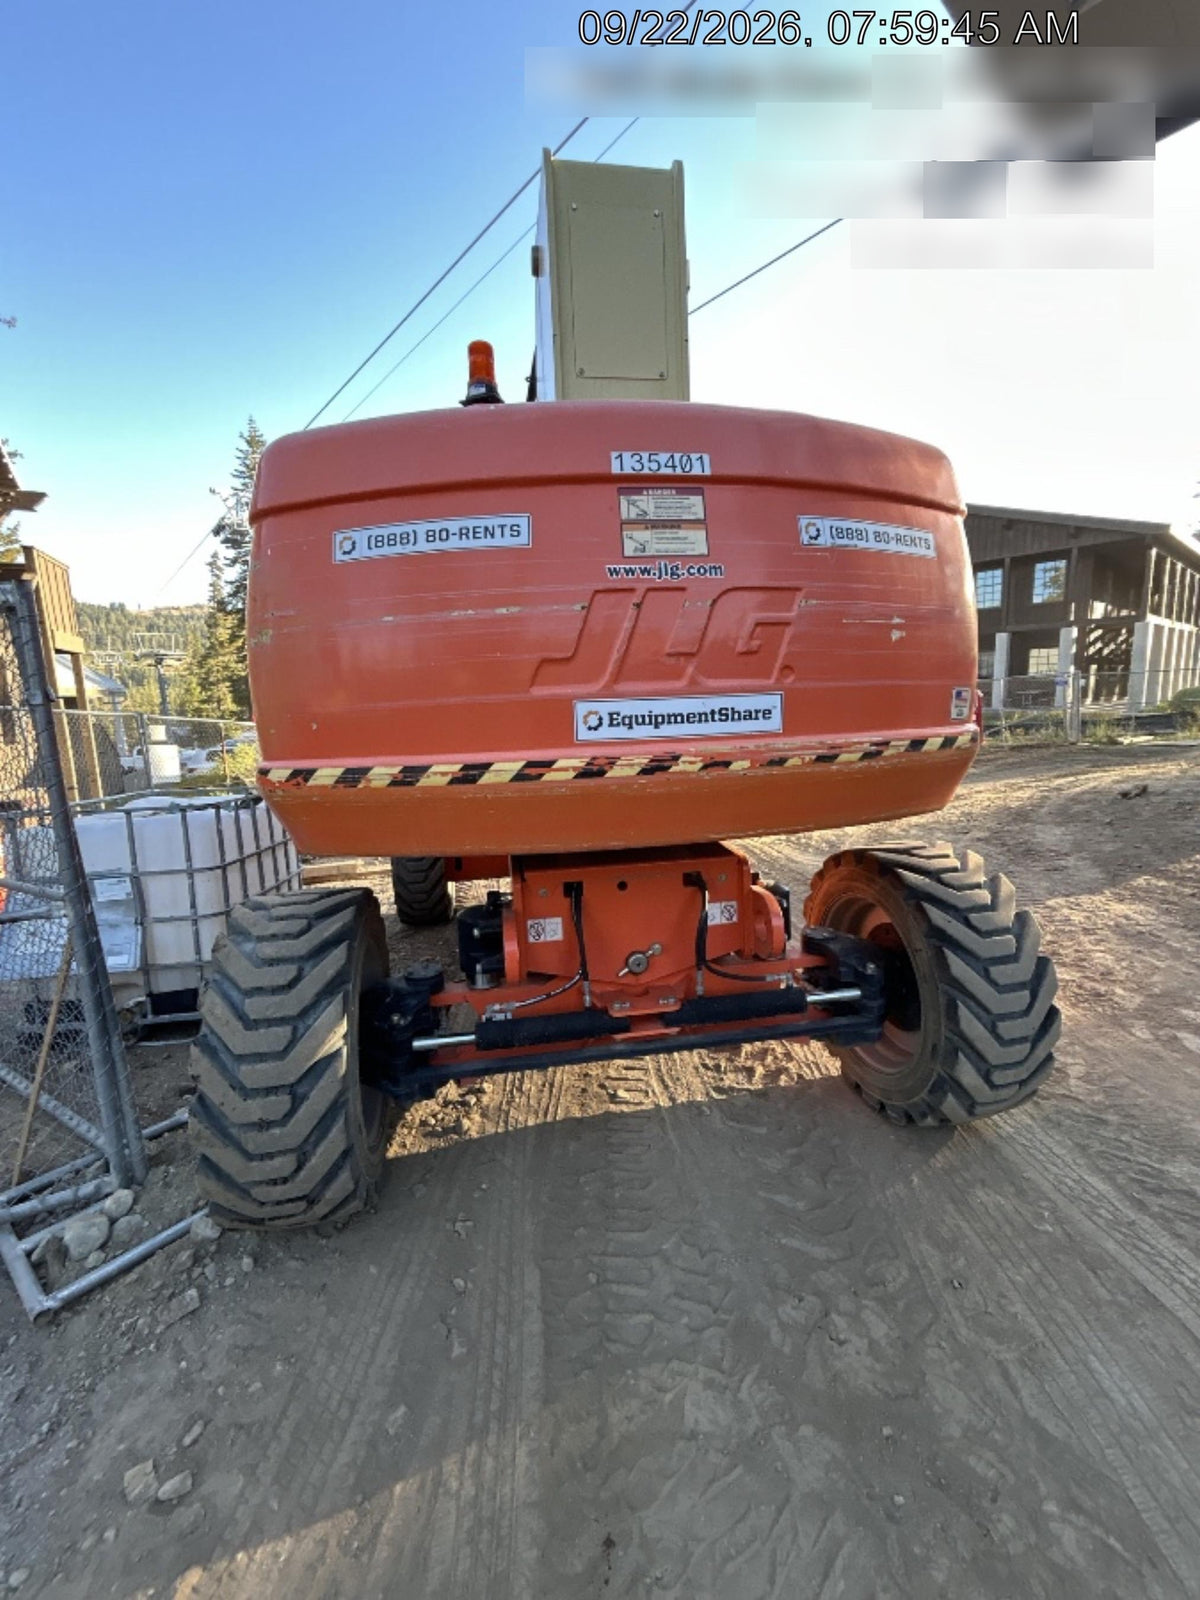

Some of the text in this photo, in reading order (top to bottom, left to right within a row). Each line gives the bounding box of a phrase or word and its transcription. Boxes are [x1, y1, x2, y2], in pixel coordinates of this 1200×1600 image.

[614, 453, 705, 473] 135401
[367, 530, 418, 550] (888)
[829, 525, 869, 543] (888)
[607, 561, 723, 580] www.jlg.com
[530, 586, 801, 691] JLG
[607, 707, 773, 731] EquipmentShare
